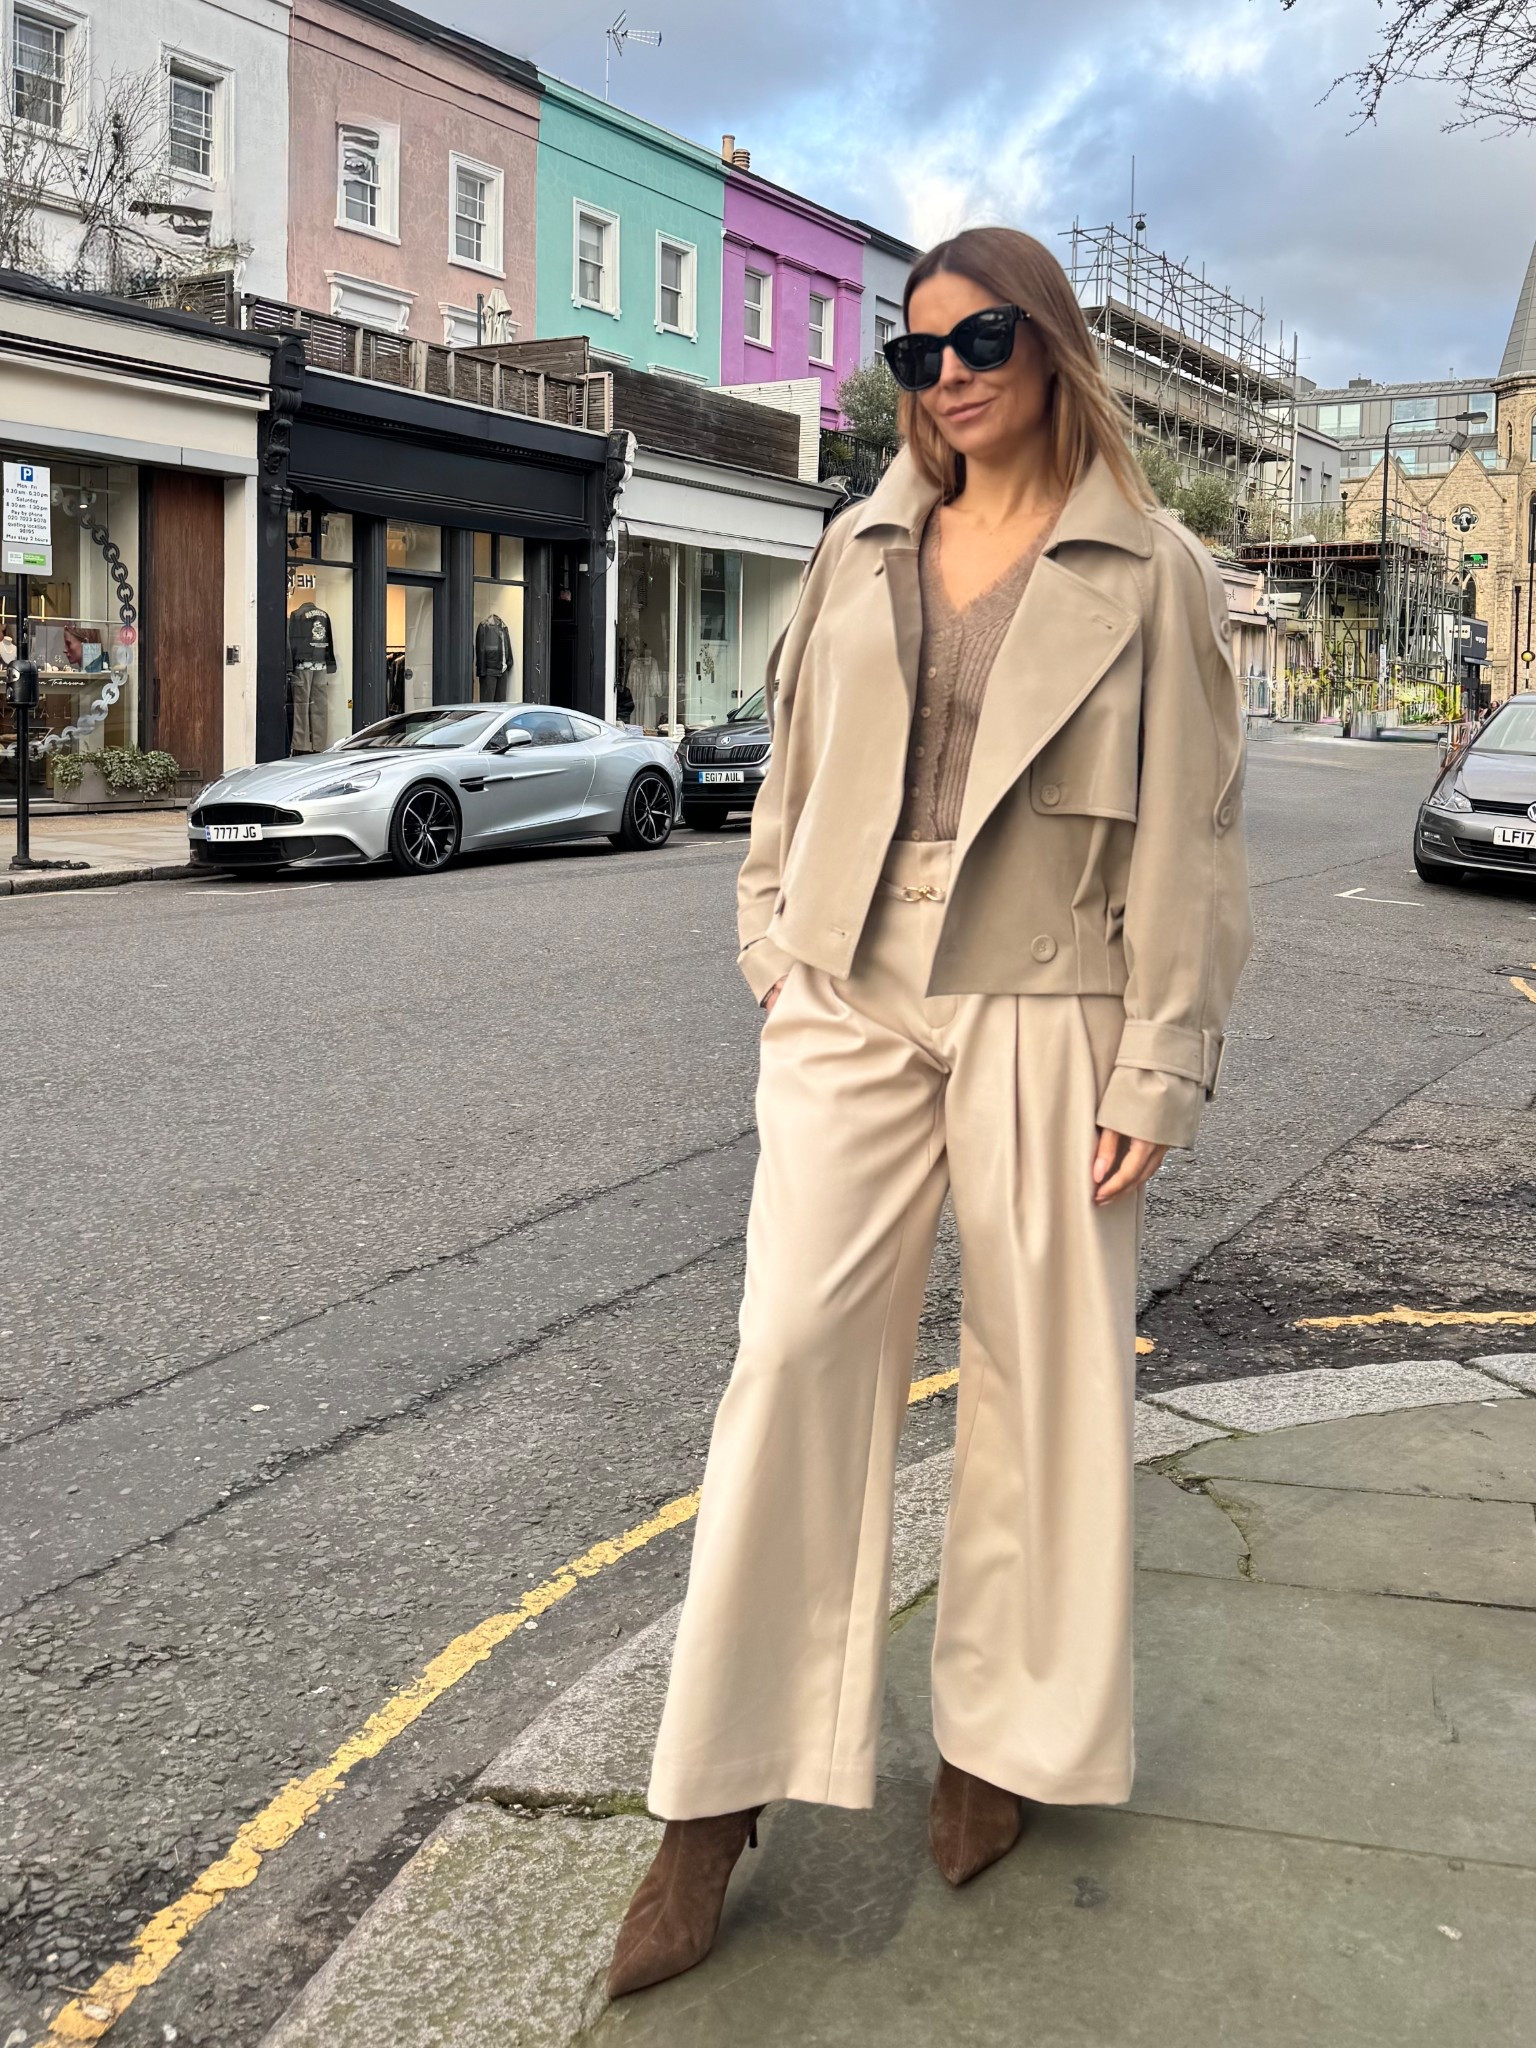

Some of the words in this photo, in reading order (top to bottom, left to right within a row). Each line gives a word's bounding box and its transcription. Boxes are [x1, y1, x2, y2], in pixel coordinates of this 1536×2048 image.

[23, 468, 31, 480] P
[17, 496, 38, 504] Saturday
[705, 772, 723, 782] EG17
[724, 773, 741, 782] AUL
[213, 827, 239, 839] 7777
[242, 826, 256, 838] JG
[1502, 829, 1535, 845] LF17
